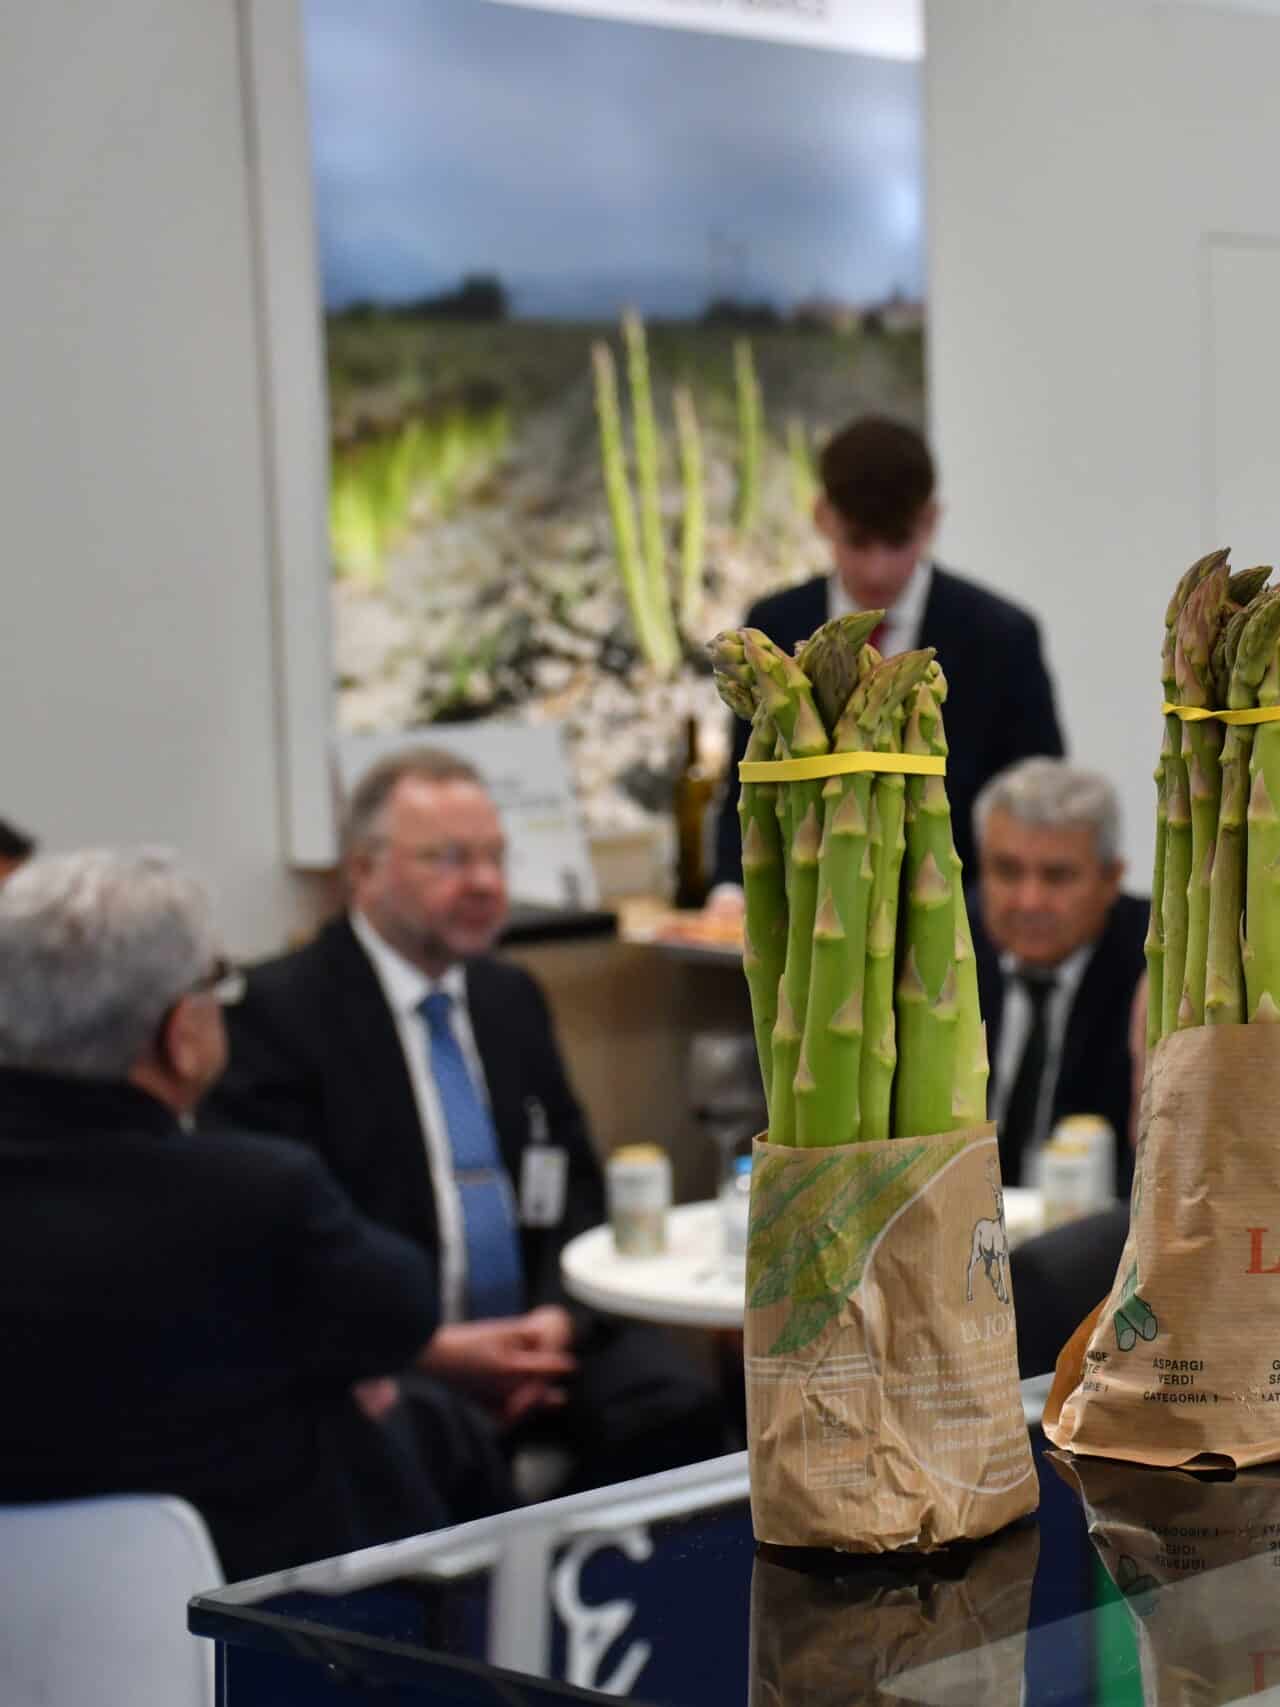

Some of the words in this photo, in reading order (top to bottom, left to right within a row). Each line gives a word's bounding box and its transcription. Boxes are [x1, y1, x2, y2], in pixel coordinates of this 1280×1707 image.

[1152, 1357, 1204, 1372] ASPARGI
[1158, 1374, 1194, 1386] VERDI
[1143, 1391, 1208, 1404] CATEGORIA
